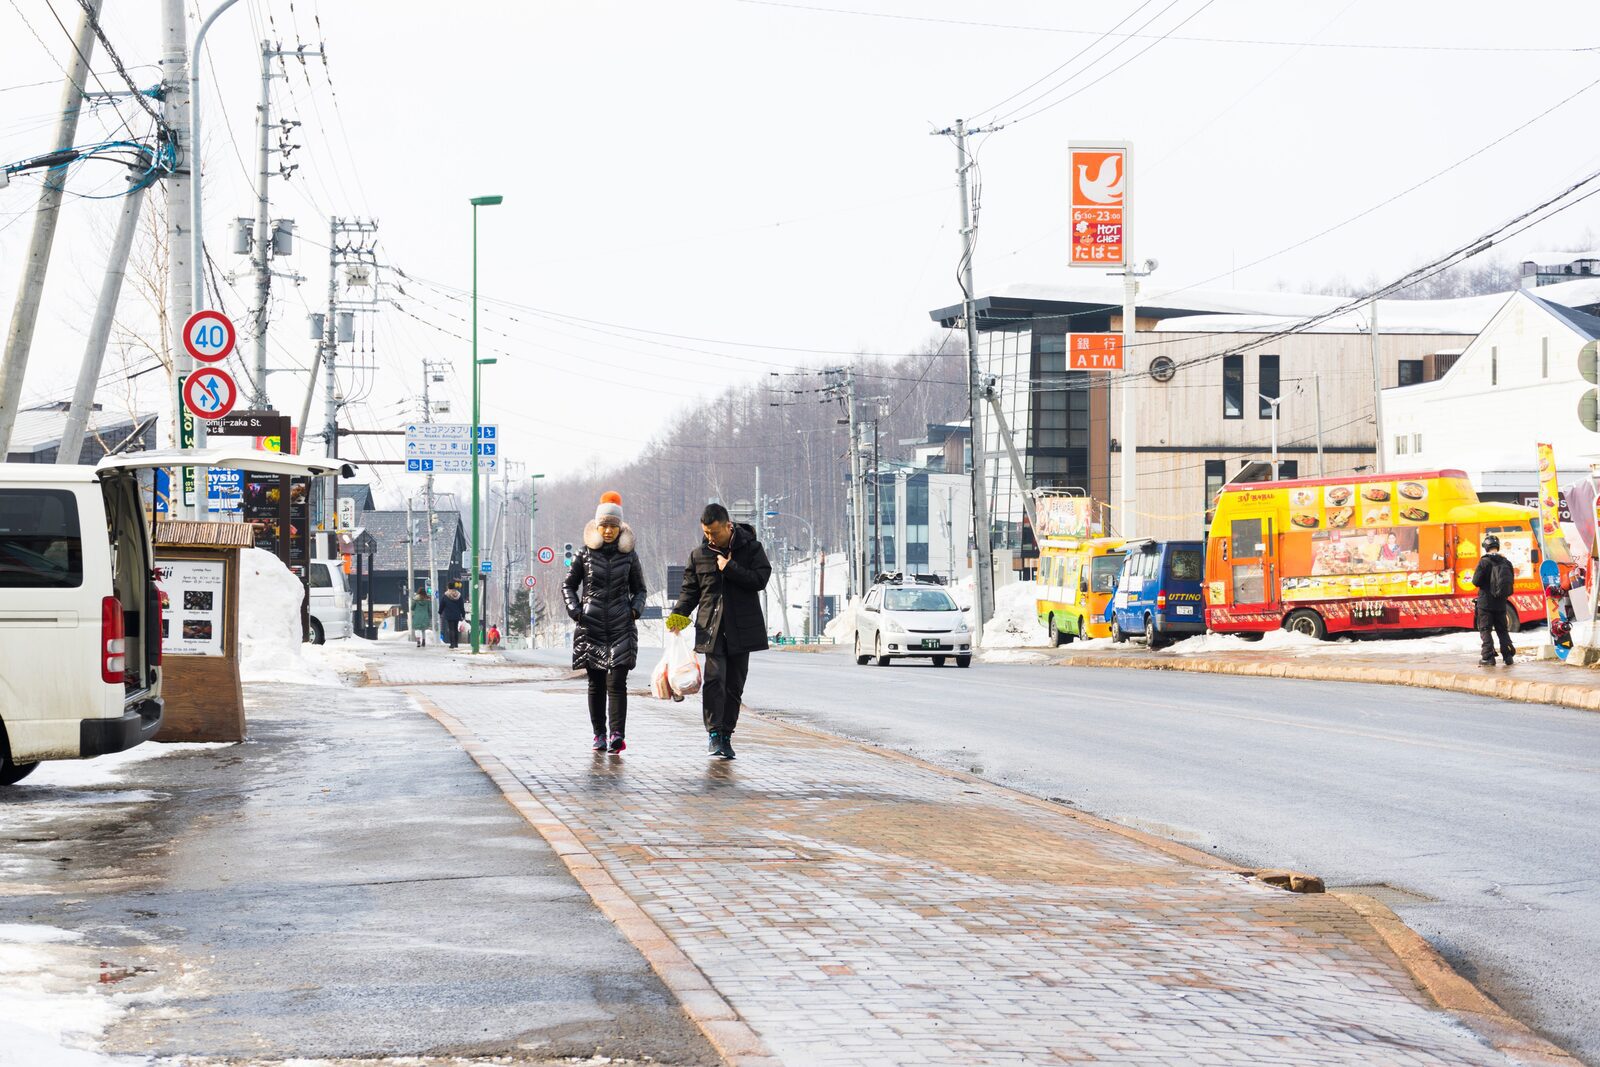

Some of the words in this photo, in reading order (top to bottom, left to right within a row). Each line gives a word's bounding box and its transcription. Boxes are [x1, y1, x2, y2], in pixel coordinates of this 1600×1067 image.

[1097, 224, 1121, 234] HOT
[1096, 235, 1121, 243] CHEF
[1075, 245, 1120, 259] たばこ
[195, 325, 224, 348] 40
[1077, 337, 1117, 351] 銀行
[1077, 354, 1117, 367] ATM
[206, 418, 248, 427] omiji-zaka
[250, 418, 262, 427] St.
[541, 551, 551, 560] 40
